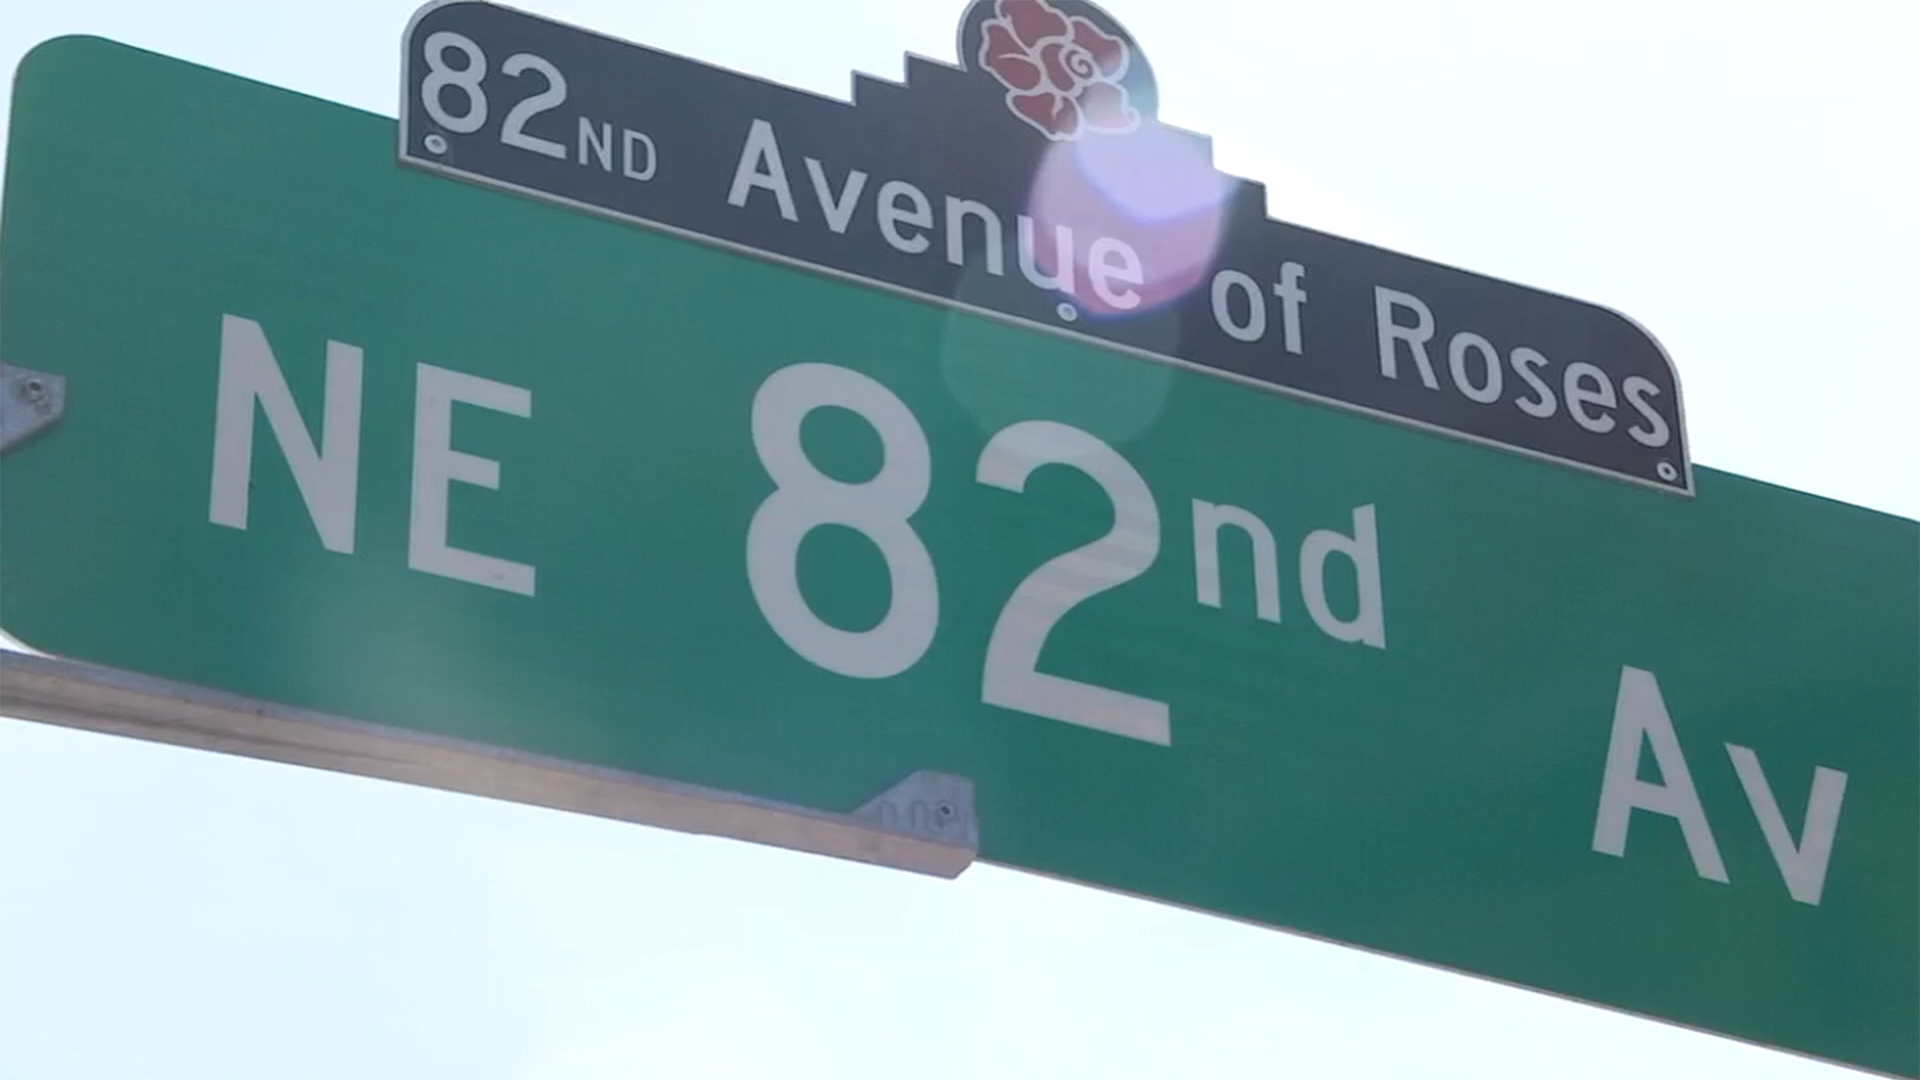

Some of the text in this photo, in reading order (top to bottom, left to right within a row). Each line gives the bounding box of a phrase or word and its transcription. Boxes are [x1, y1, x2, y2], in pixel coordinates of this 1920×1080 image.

[420, 31, 1671, 449] 82ND Avenue of Roses
[207, 313, 1849, 907] NE 82nd Av
